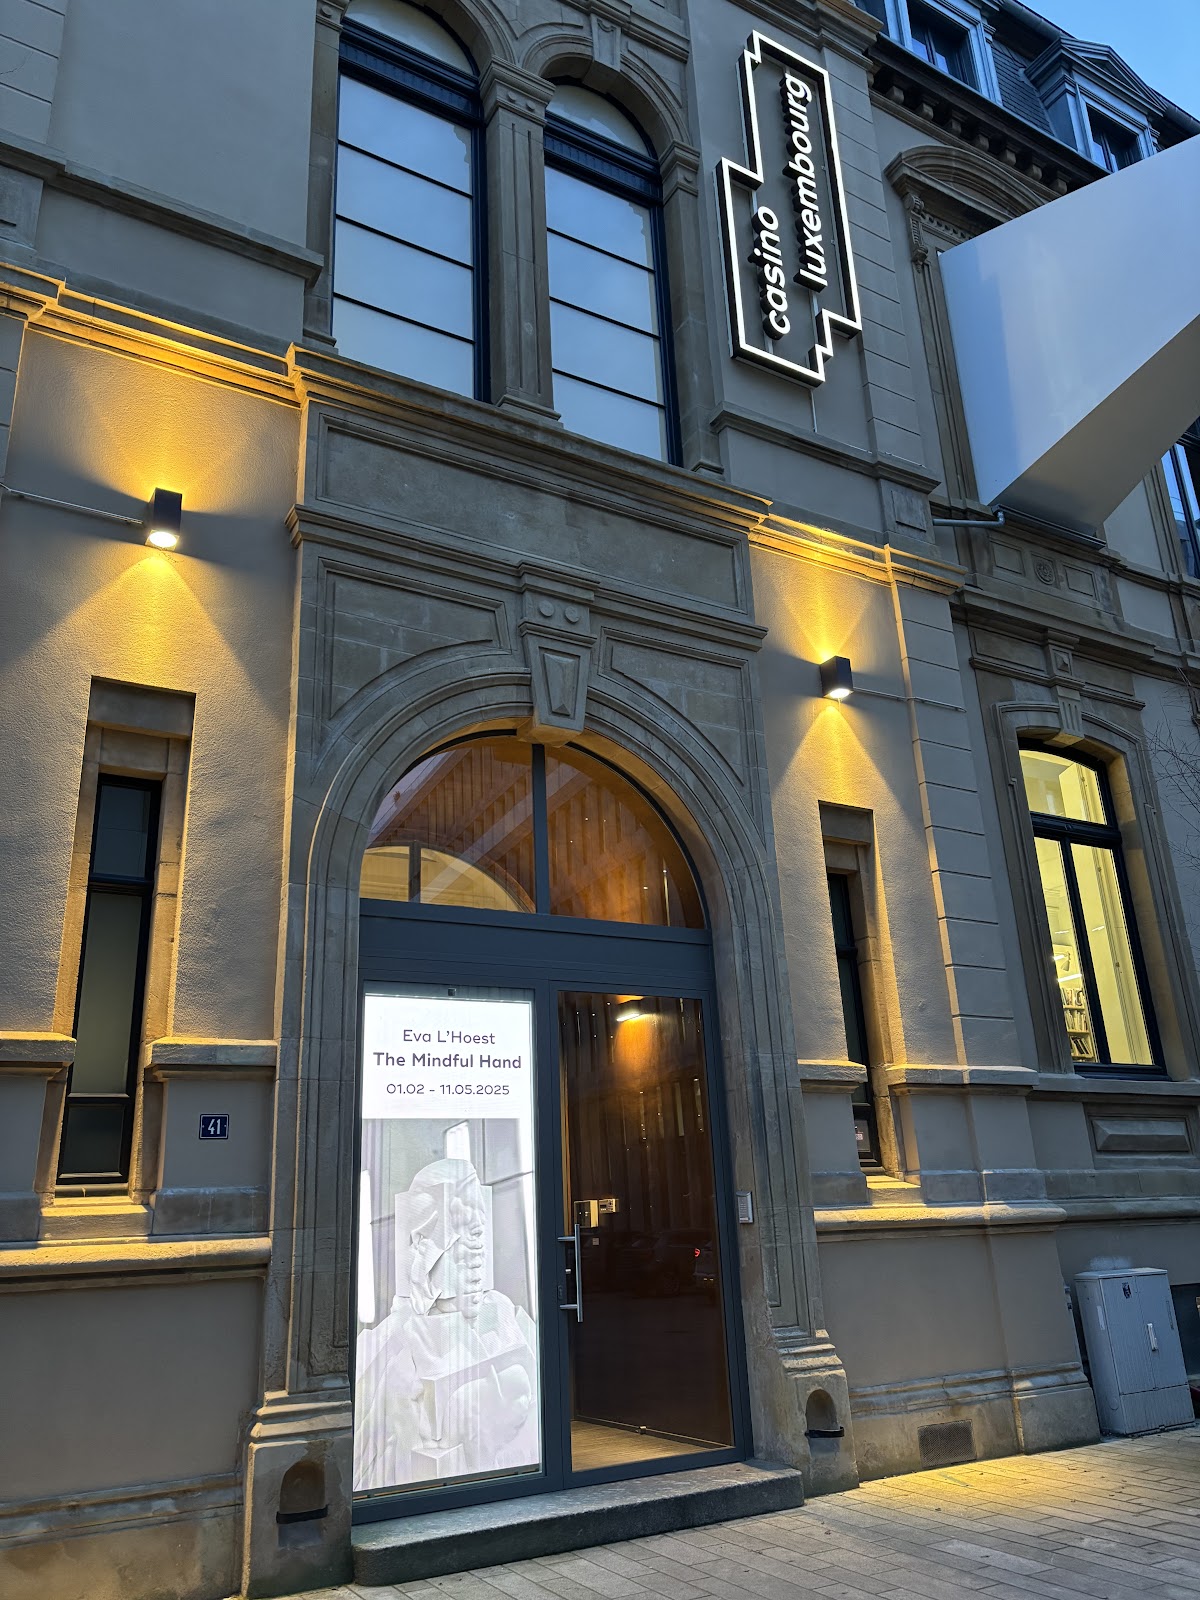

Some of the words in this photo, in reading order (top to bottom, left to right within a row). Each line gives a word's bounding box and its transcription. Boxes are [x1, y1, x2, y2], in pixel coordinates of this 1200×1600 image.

[785, 73, 828, 286] luxembourg
[753, 205, 791, 336] casino
[403, 1029, 431, 1042] Eva
[437, 1030, 496, 1045] L’Hoest
[373, 1052, 406, 1066] The
[412, 1053, 474, 1068] Mindful
[479, 1055, 522, 1069] Hand
[386, 1083, 425, 1095] 01.02
[439, 1084, 510, 1096] 11.05.2025
[208, 1118, 221, 1134] 41
